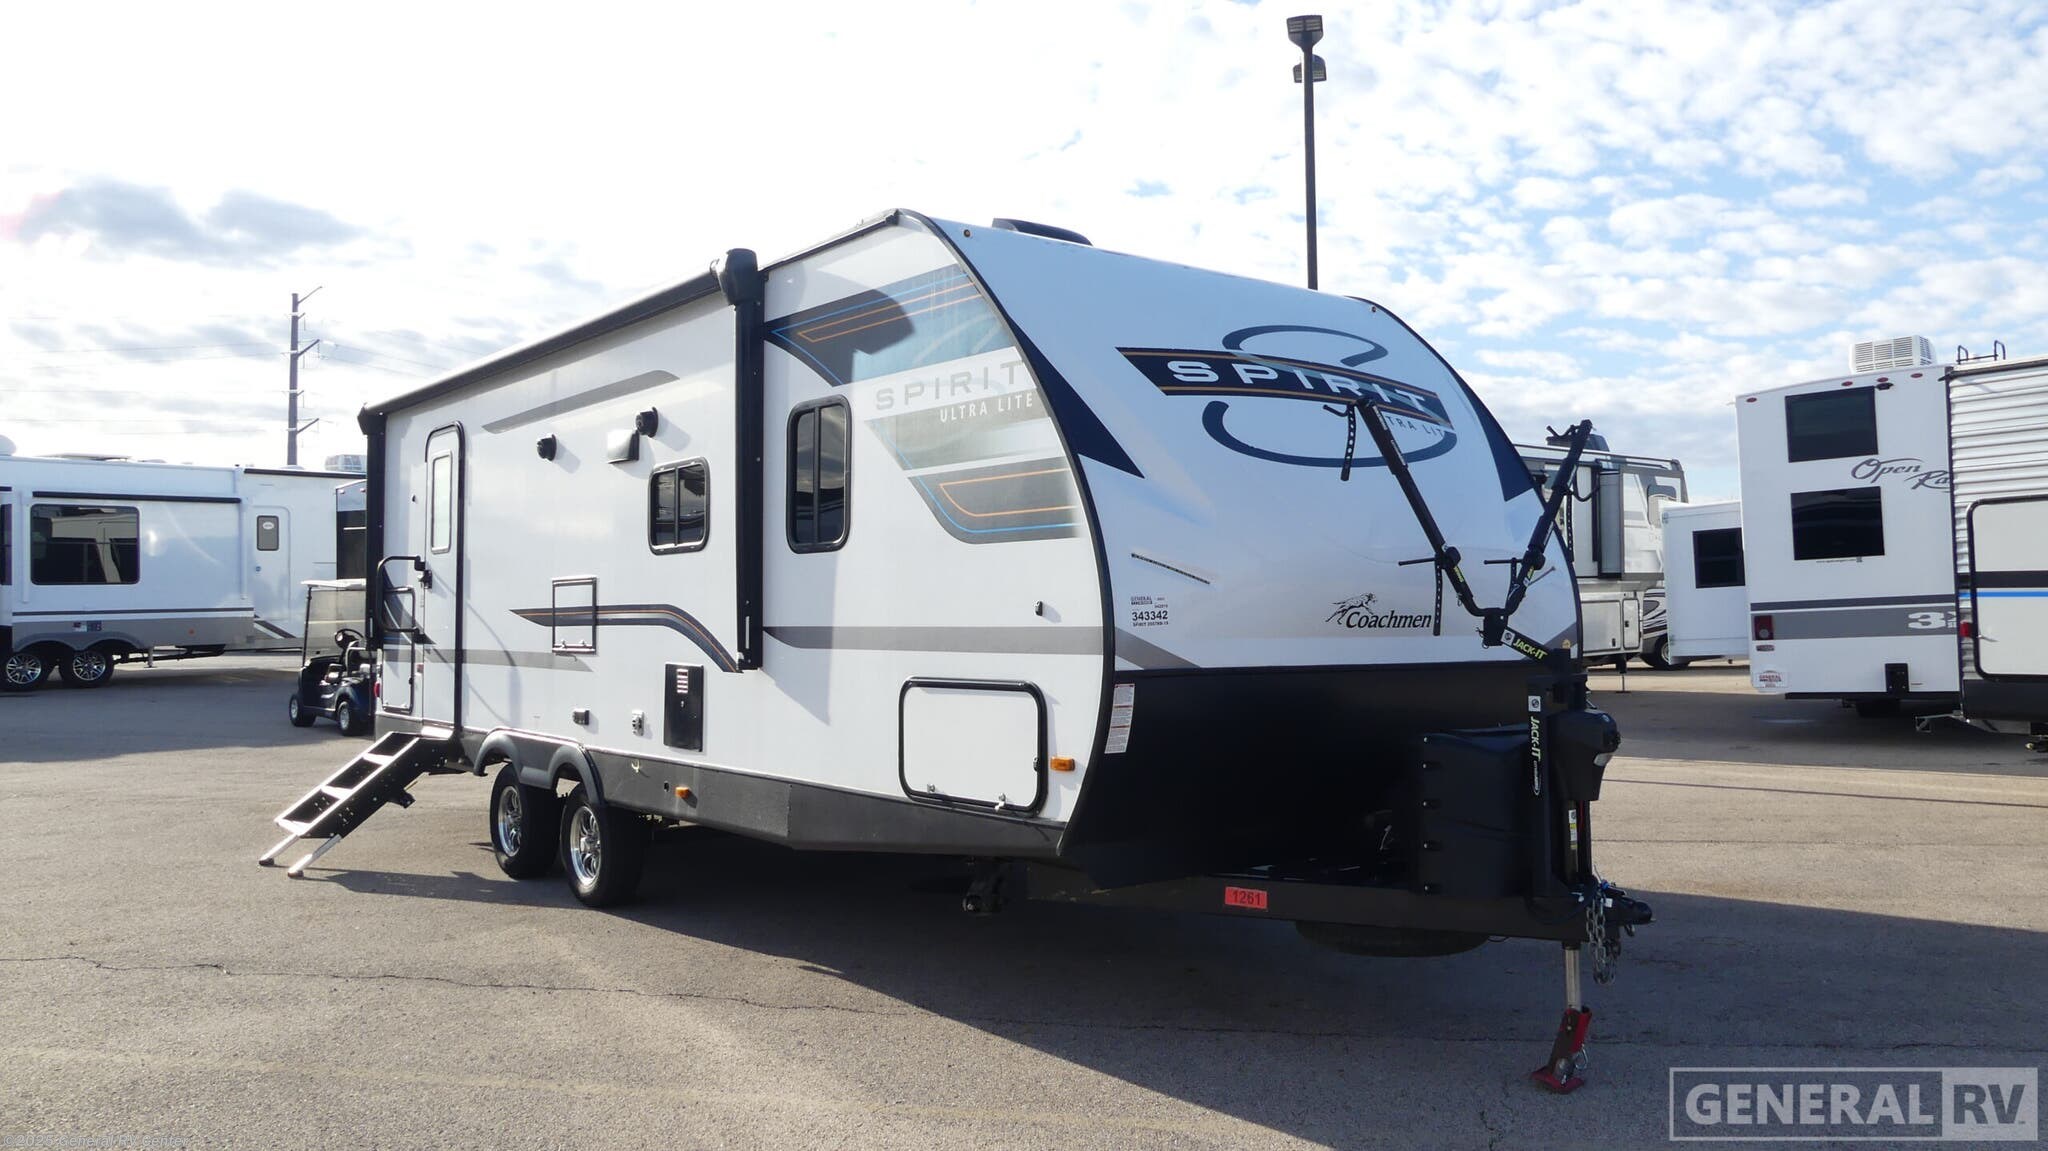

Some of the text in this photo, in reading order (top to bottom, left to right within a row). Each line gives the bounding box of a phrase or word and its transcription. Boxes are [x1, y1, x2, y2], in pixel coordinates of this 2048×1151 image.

[876, 360, 1022, 411] SPIRIT
[1167, 361, 1426, 412] SPIRIT
[940, 393, 1033, 423] ULTRA LITE
[1385, 416, 1417, 432] TRA
[1851, 458, 1924, 483] Open
[1904, 470, 1950, 491] Ra
[1132, 610, 1168, 621] 343342
[1346, 610, 1431, 628] Coachmen
[1513, 639, 1548, 660] JACK-IT
[1530, 715, 1541, 762] JACK-IT
[1232, 890, 1261, 906] 1261
